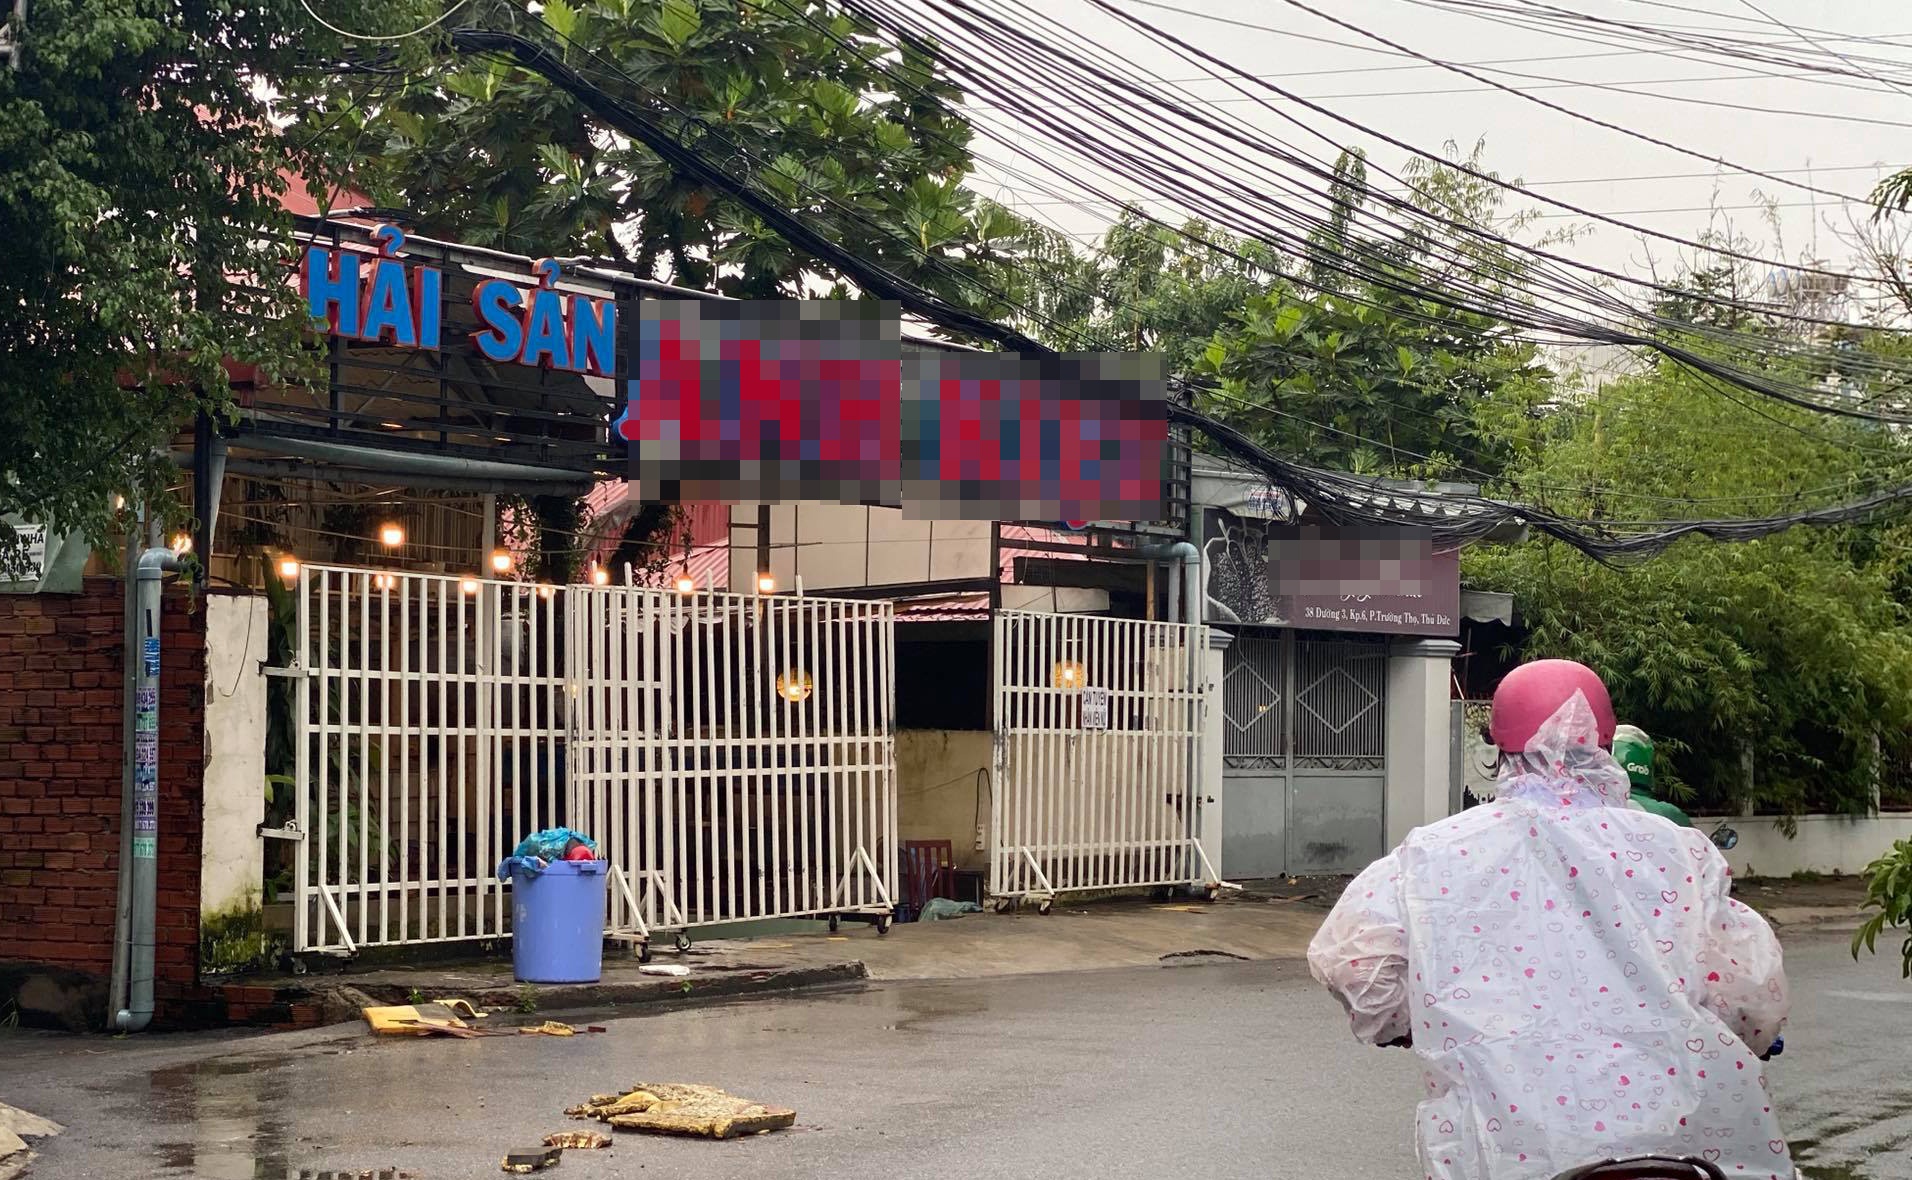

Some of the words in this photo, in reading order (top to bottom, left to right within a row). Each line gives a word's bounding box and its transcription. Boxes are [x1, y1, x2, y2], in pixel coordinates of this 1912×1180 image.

[300, 223, 442, 351] HẢI
[471, 257, 617, 377] SẢN
[1305, 606, 1314, 618] 38
[1627, 762, 1650, 776] Grab
